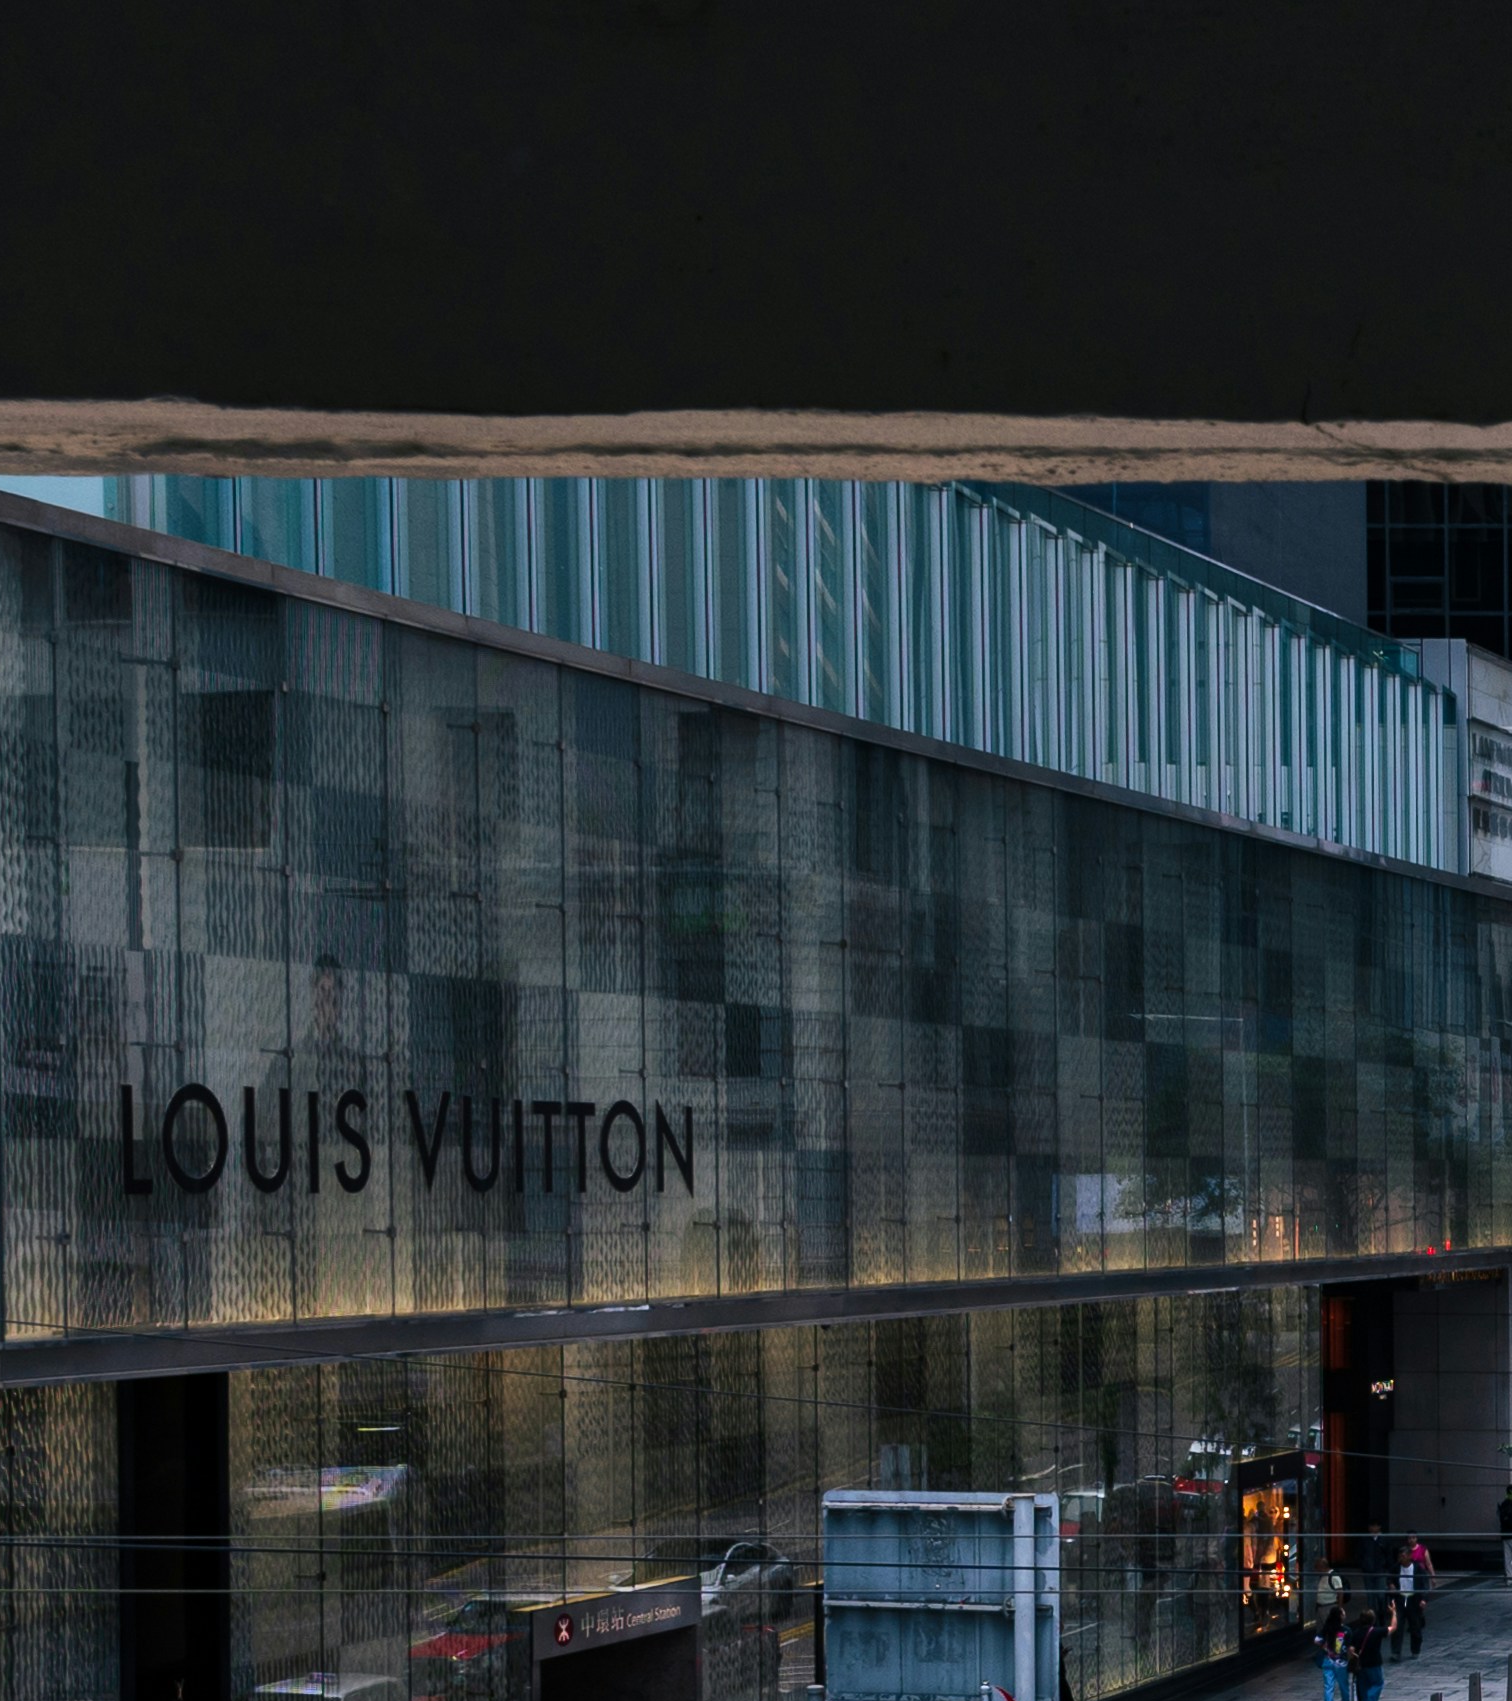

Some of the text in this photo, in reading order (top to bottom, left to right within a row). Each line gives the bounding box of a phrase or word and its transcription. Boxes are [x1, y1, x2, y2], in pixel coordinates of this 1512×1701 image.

[119, 1083, 697, 1198] LOUIS VUITTON
[581, 1604, 681, 1638] 中環站 Central Station
